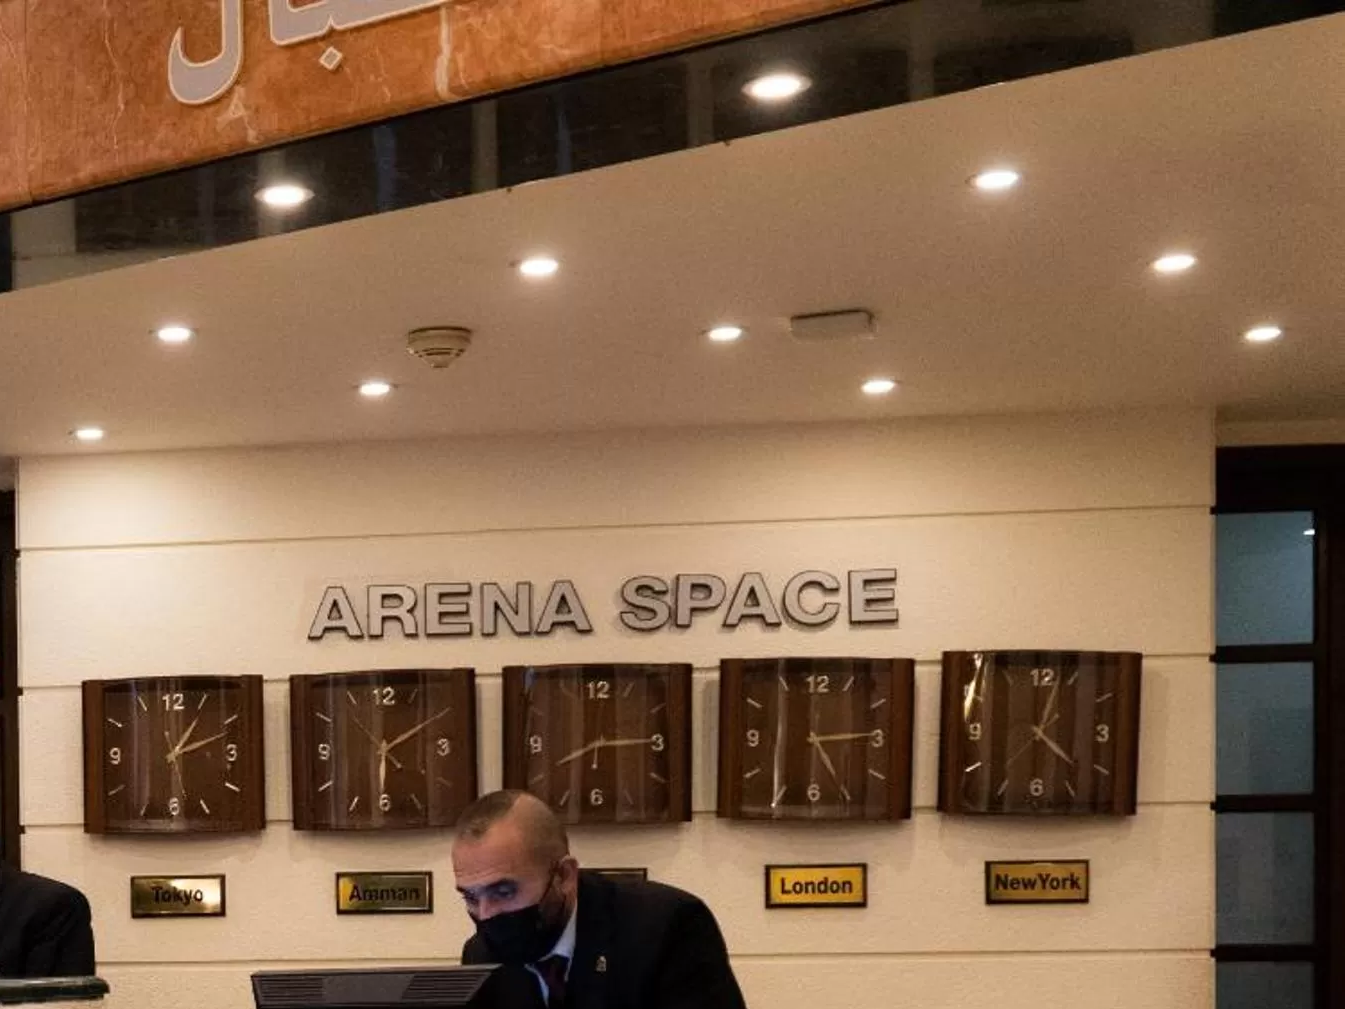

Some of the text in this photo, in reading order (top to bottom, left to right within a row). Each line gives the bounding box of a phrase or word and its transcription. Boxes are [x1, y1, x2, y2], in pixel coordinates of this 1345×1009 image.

[308, 568, 899, 640] ARENA SPACE
[807, 676, 829, 694] 12
[1030, 669, 1054, 687] 12
[372, 687, 394, 705] 12
[588, 681, 610, 699] 12
[162, 693, 184, 710] 12
[747, 729, 759, 747] 9
[872, 729, 883, 747] 3
[969, 723, 981, 740] 9
[1096, 725, 1109, 742] 3
[437, 739, 450, 756] 3
[652, 733, 663, 751] 3
[110, 747, 121, 765] 9
[227, 745, 237, 762] 3
[318, 743, 331, 760] 9
[808, 783, 820, 801] 6
[1030, 778, 1043, 796] 6
[169, 797, 180, 815] 6
[379, 794, 391, 812] 6
[591, 788, 602, 806] 6
[780, 876, 853, 896] London
[994, 872, 1082, 892] NewYork
[150, 885, 203, 906] Tokyo
[349, 885, 420, 902] Amman
